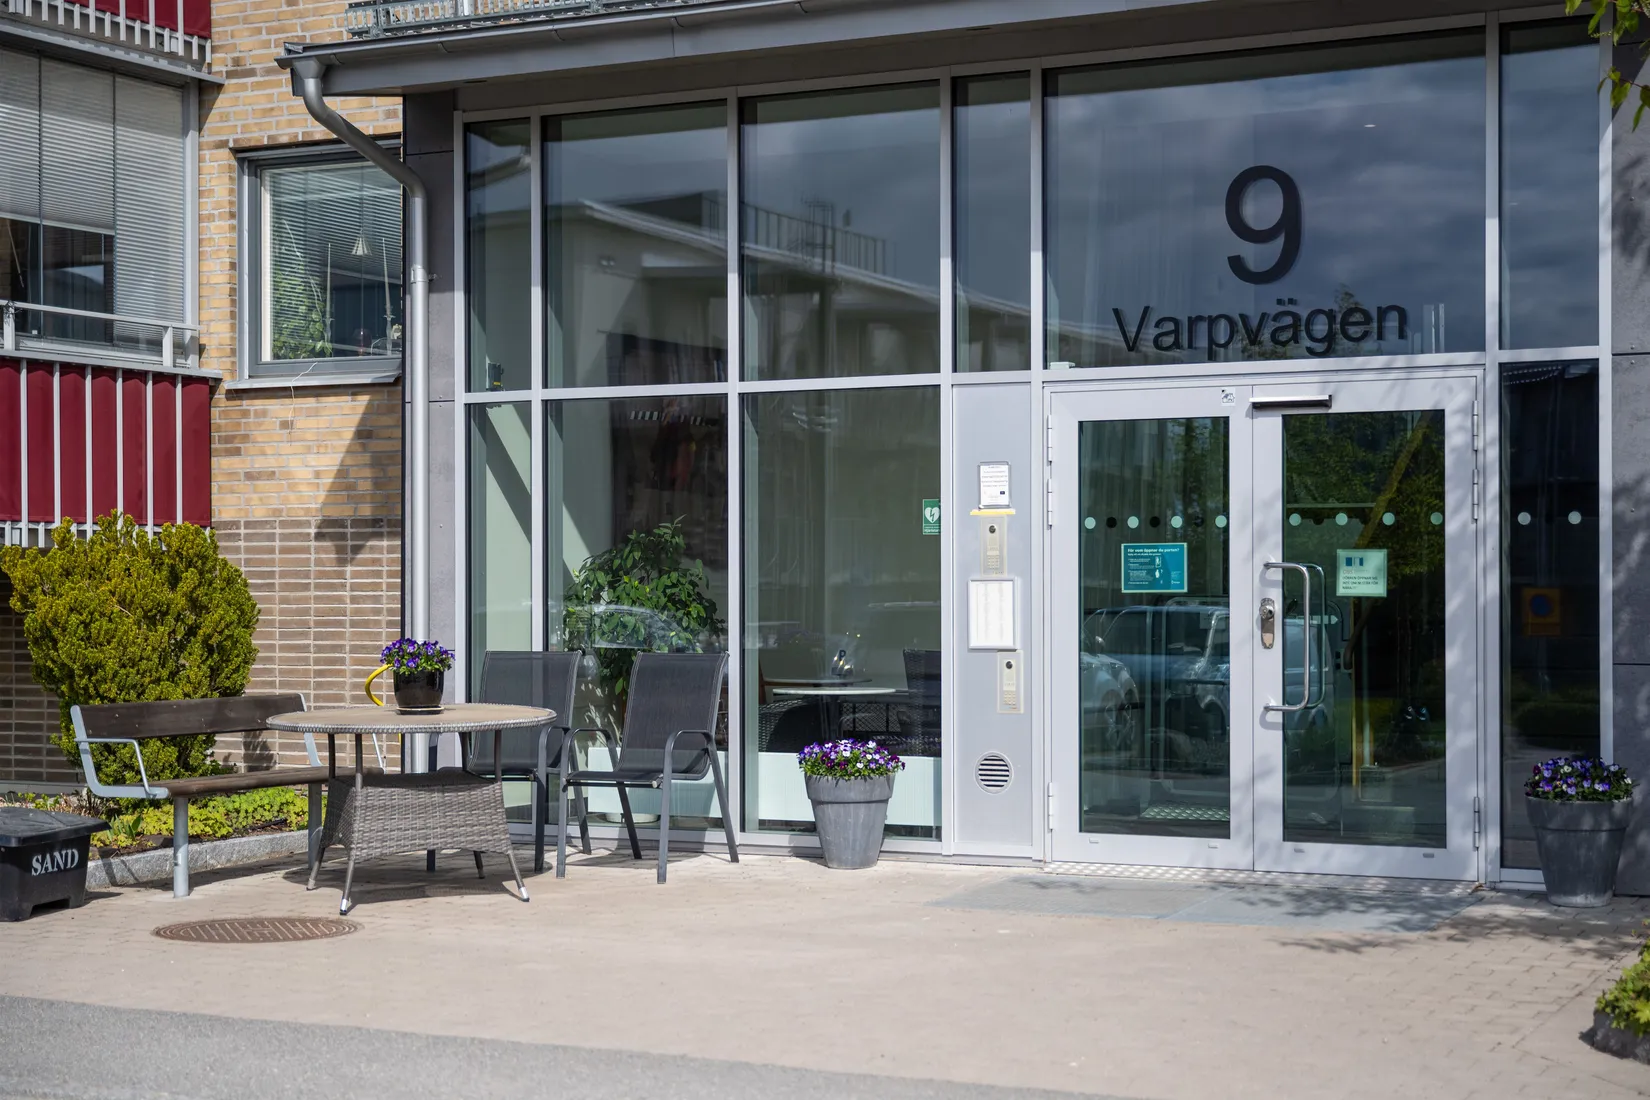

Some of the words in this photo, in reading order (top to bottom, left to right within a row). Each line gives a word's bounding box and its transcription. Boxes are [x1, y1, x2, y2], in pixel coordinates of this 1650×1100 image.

[1225, 165, 1303, 285] 9
[1112, 298, 1407, 361] Varpvägen
[31, 849, 79, 876] SAND
